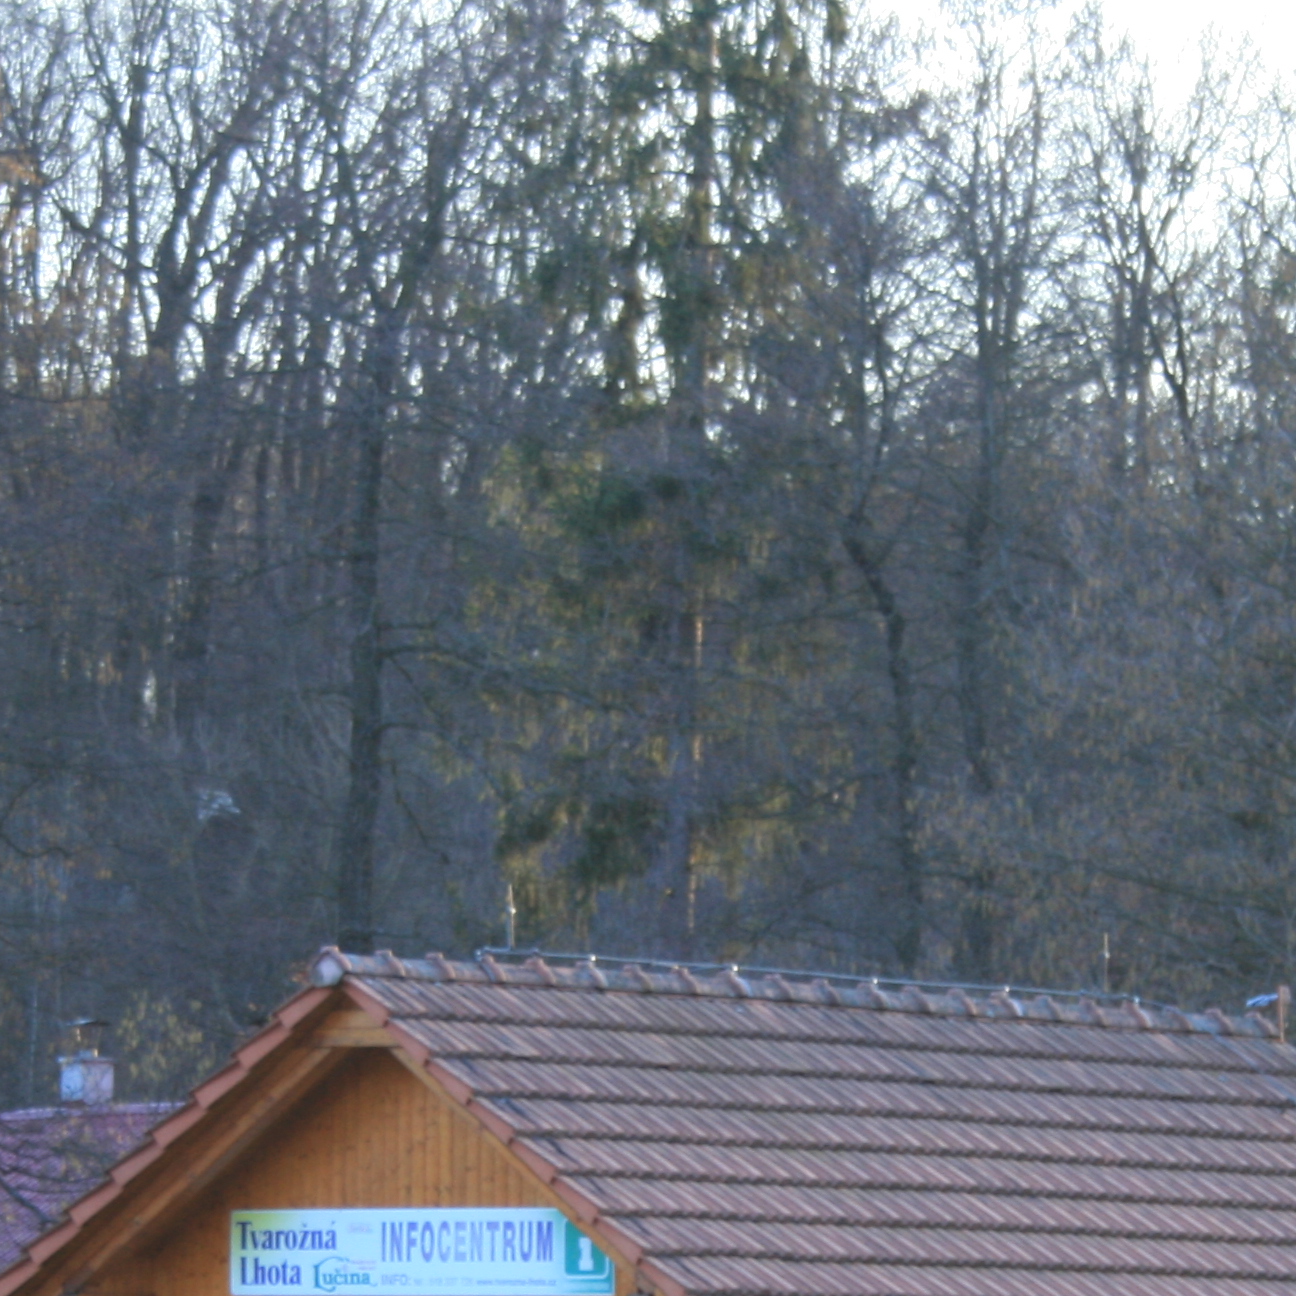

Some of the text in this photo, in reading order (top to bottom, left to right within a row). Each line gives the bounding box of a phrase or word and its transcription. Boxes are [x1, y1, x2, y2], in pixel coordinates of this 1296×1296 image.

[236, 1220, 337, 1251] Tvarožná
[381, 1220, 554, 1263] INFOCENTRUM
[240, 1256, 302, 1286] Lhota
[313, 1256, 377, 1293] Lučina
